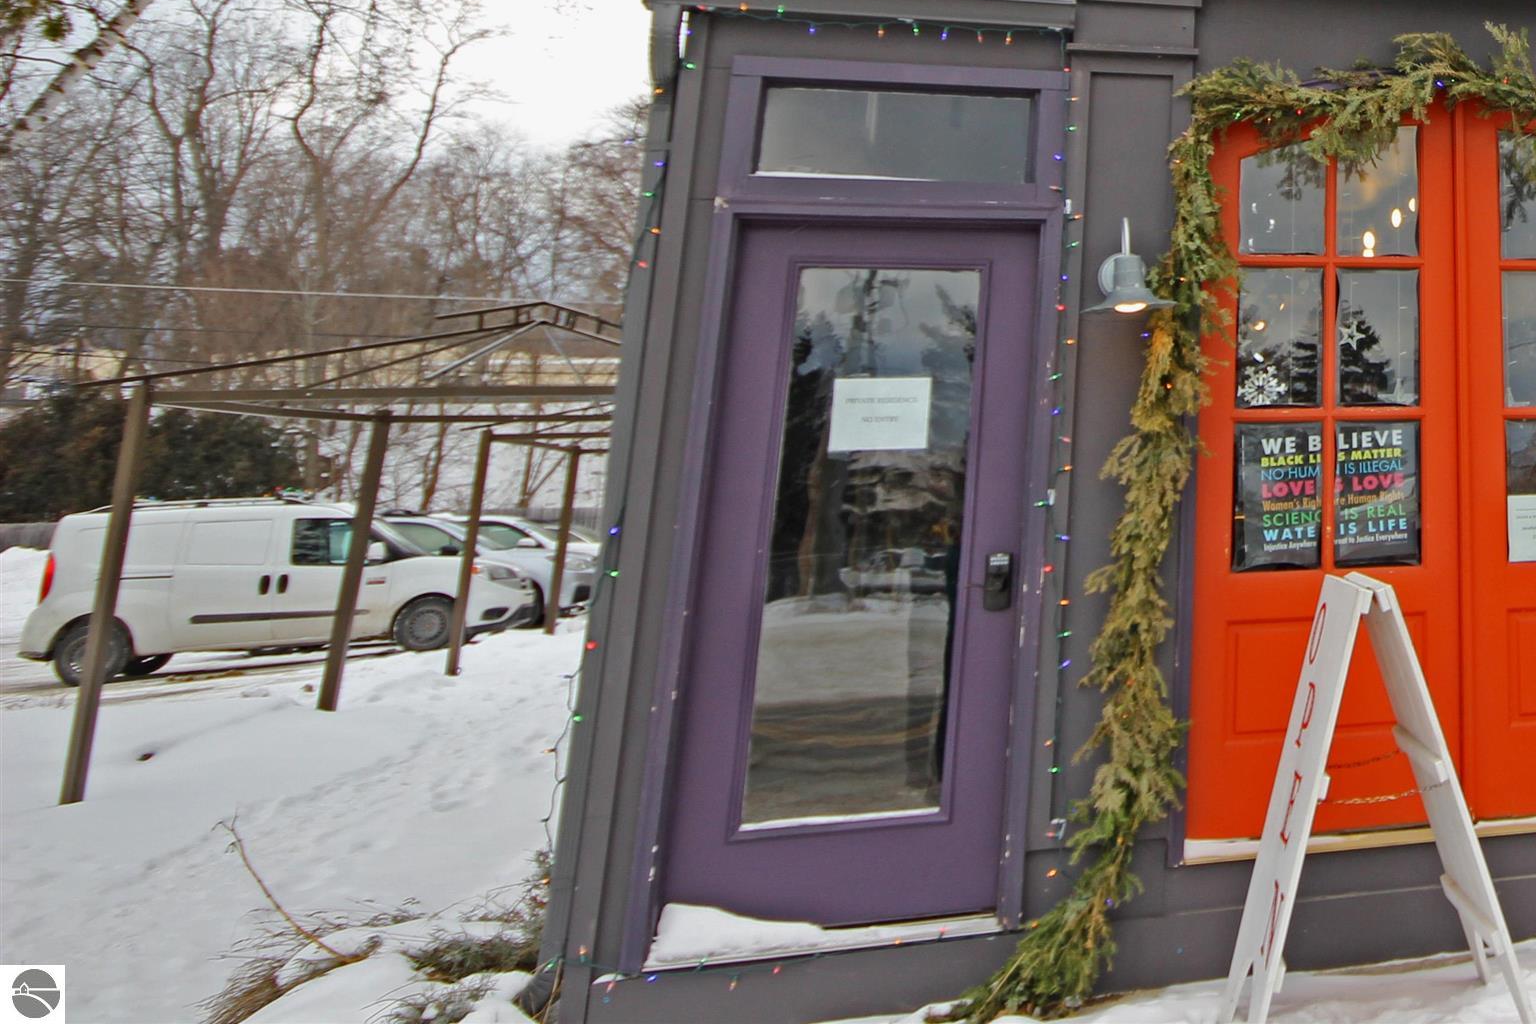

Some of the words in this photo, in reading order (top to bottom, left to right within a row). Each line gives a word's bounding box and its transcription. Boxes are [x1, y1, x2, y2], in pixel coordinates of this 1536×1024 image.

[1261, 436, 1297, 455] WE
[1308, 429, 1403, 452] BLIEVE
[1261, 455, 1304, 467] BLACK
[1309, 450, 1346, 464] LIS
[1351, 448, 1402, 461] MATTER
[1261, 468, 1284, 481] NO
[1345, 463, 1355, 474] IS
[1359, 460, 1403, 473] ILLEGAL
[1261, 480, 1315, 499] LOVE
[1352, 473, 1404, 492] LOVE
[1263, 498, 1300, 511] Women's
[1347, 493, 1377, 505] Human
[1263, 509, 1322, 527] SCIENC
[1344, 506, 1359, 520] IS
[1367, 504, 1406, 518] REAL
[1263, 526, 1316, 542] WATE
[1340, 523, 1357, 535] IS
[1368, 518, 1408, 532] LIFE
